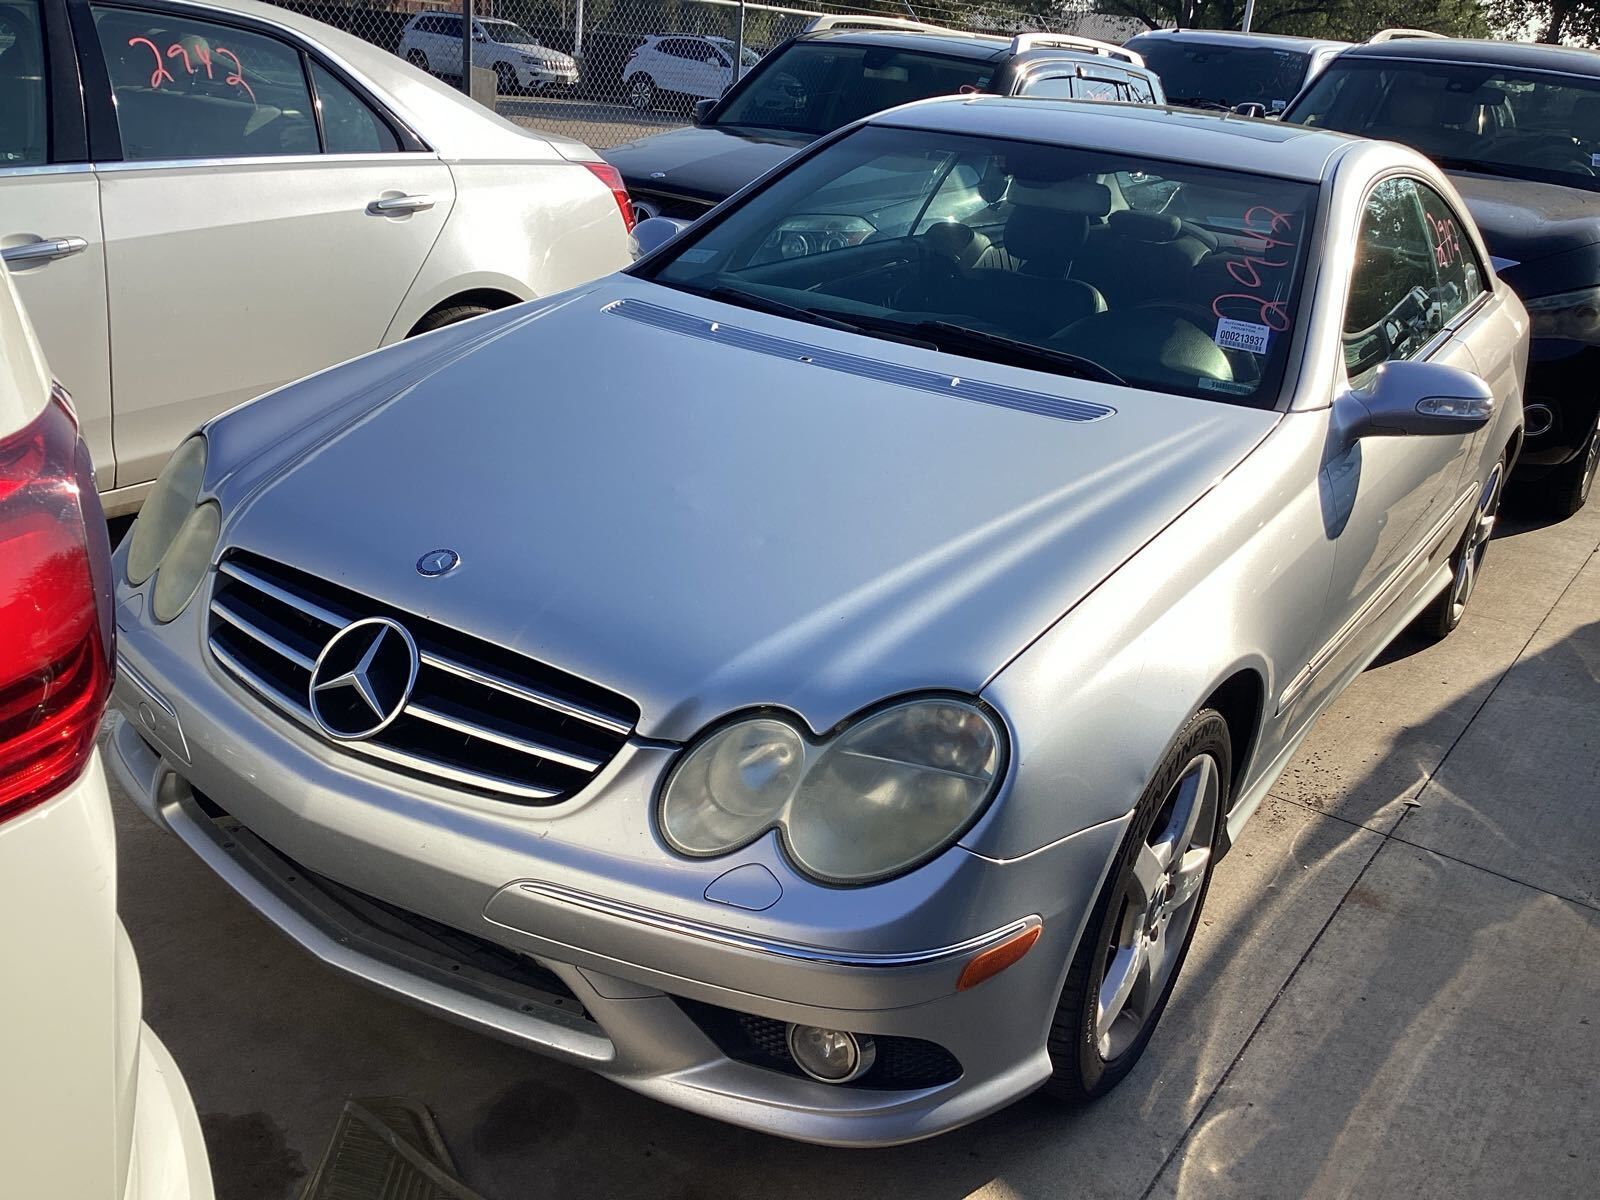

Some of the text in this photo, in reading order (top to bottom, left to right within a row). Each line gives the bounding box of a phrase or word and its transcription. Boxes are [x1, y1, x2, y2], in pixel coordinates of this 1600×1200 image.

[128, 37, 259, 110] 2942
[1212, 205, 1296, 332] 2942
[1220, 329, 1265, 346] 000213937
